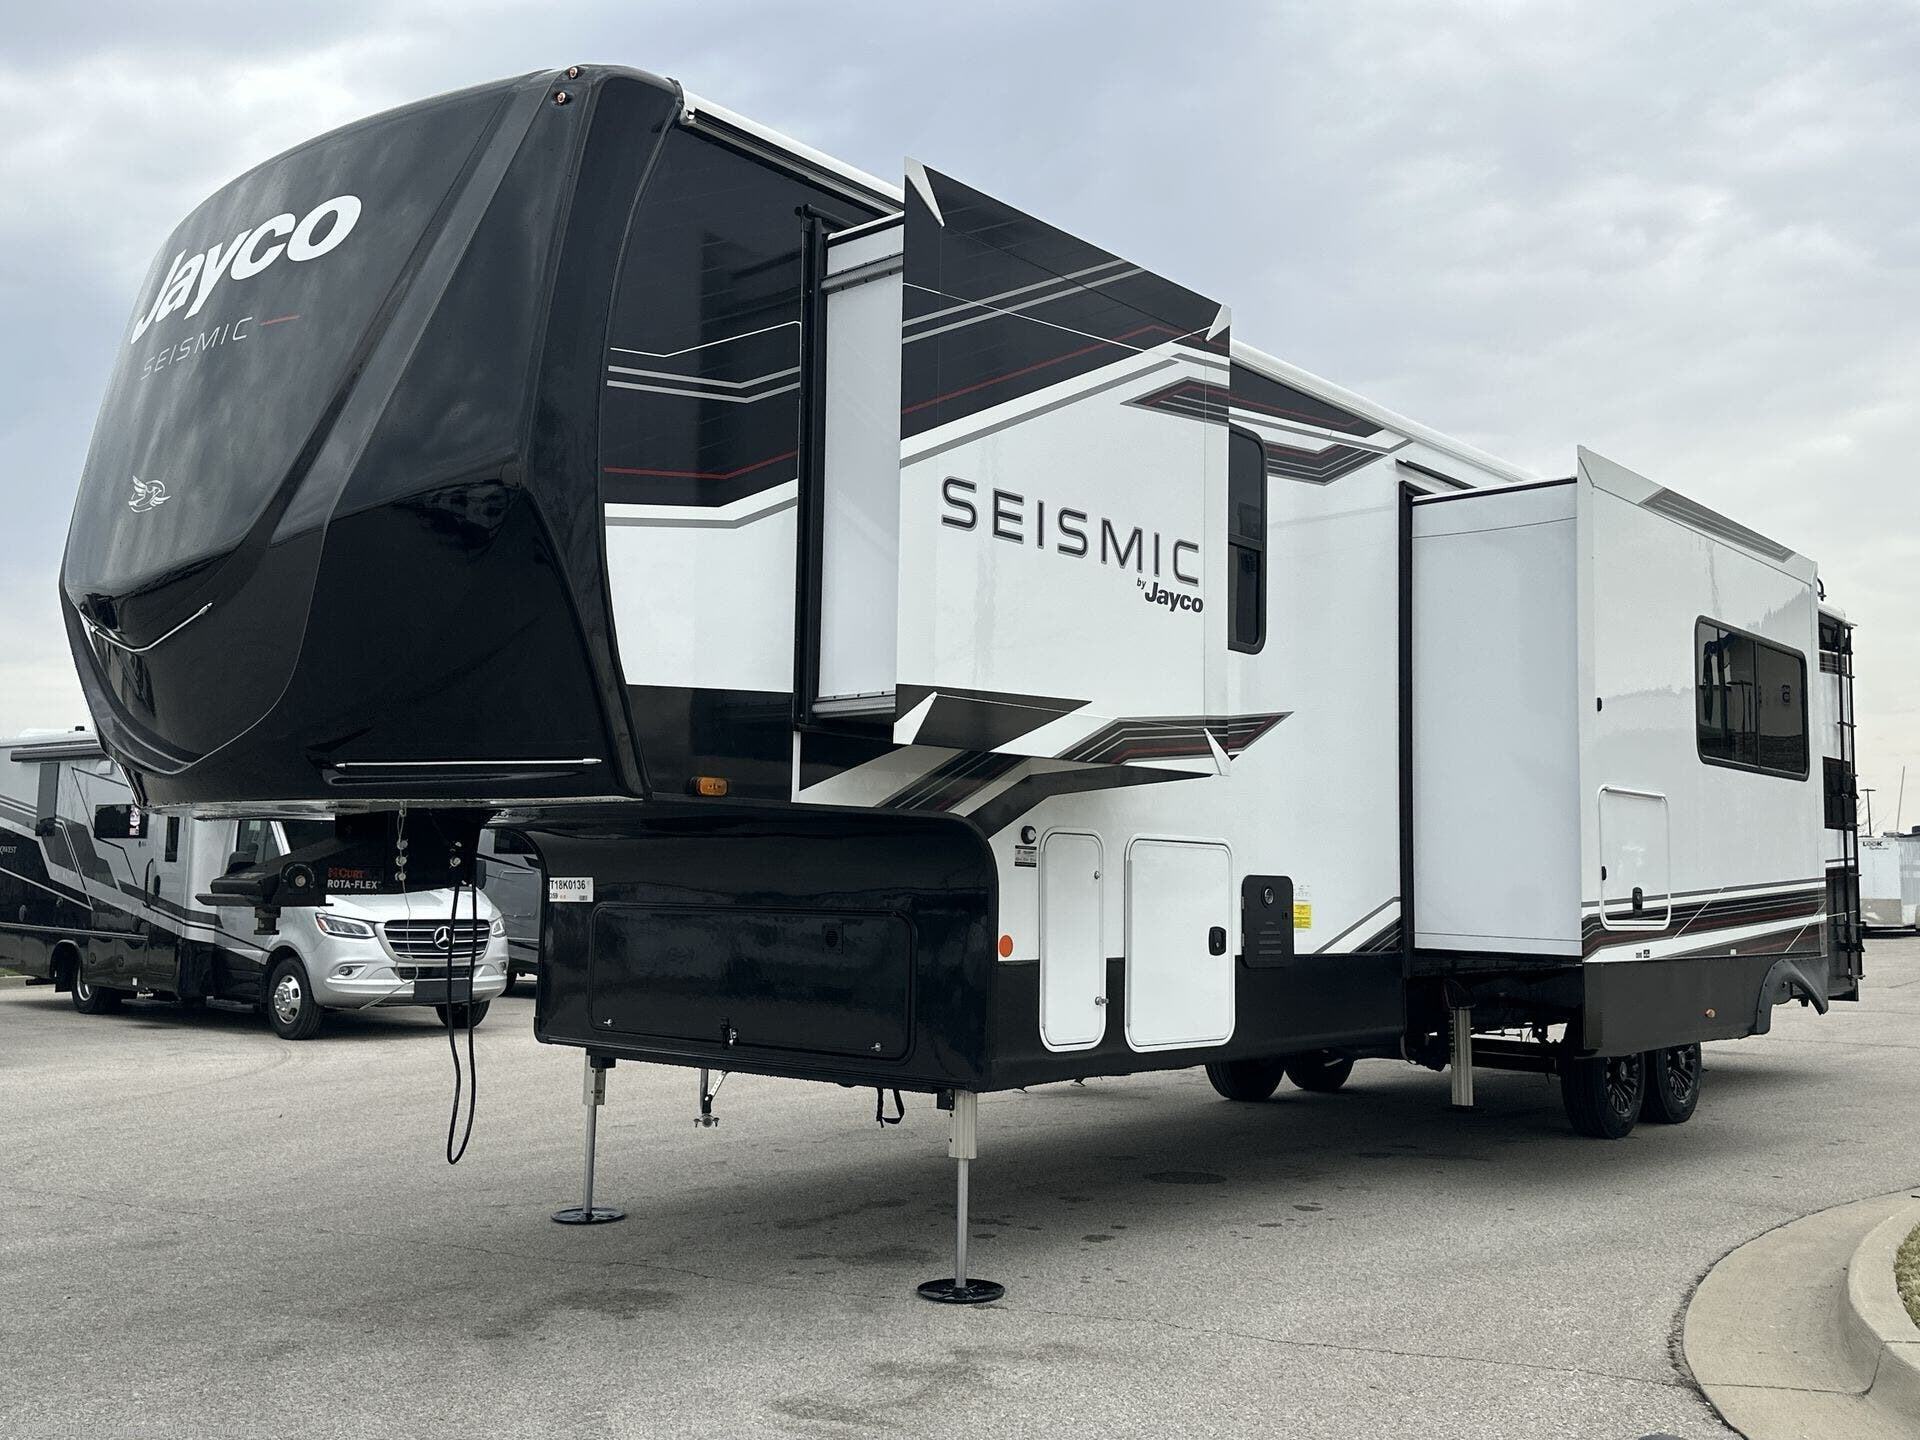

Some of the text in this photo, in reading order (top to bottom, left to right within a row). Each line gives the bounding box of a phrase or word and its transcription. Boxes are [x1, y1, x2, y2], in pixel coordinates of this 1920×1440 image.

[131, 195, 362, 344] Jayco
[140, 317, 253, 381] SEISMIC
[941, 475, 1200, 588] SEISMIC
[1136, 577, 1204, 614] by Jayco
[550, 880, 586, 890] T18K0136
